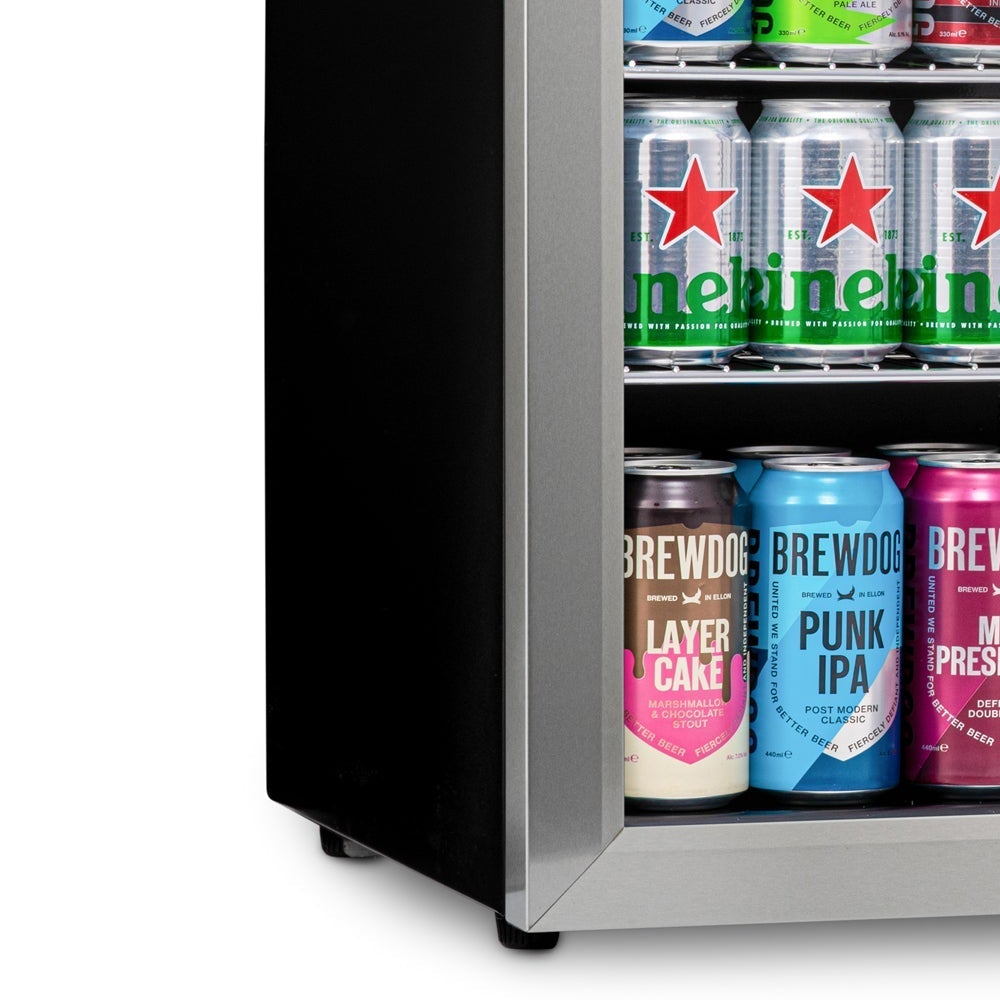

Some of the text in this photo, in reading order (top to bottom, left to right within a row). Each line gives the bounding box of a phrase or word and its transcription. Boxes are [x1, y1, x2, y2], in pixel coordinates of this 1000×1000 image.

[859, 0, 877, 8] ALE
[699, 1, 735, 28] FIERCELY
[826, 14, 851, 31] BEER
[630, 231, 654, 242] EST.
[788, 229, 812, 240] EST.
[942, 231, 966, 242] EST.
[805, 320, 828, 328] WITH
[832, 320, 867, 328] PASSION
[772, 530, 901, 577] BREWDOG
[647, 618, 730, 655] LAYER
[799, 609, 885, 651] PUNK
[771, 643, 779, 677] STAND
[654, 655, 723, 692] CAKE
[818, 654, 870, 695] IPA
[651, 708, 724, 718] & CHOCOLATE
[805, 704, 879, 714] POST MODERN
[673, 719, 708, 728] STOUT
[821, 715, 866, 724] CLASSIC
[811, 734, 839, 753] BEER
